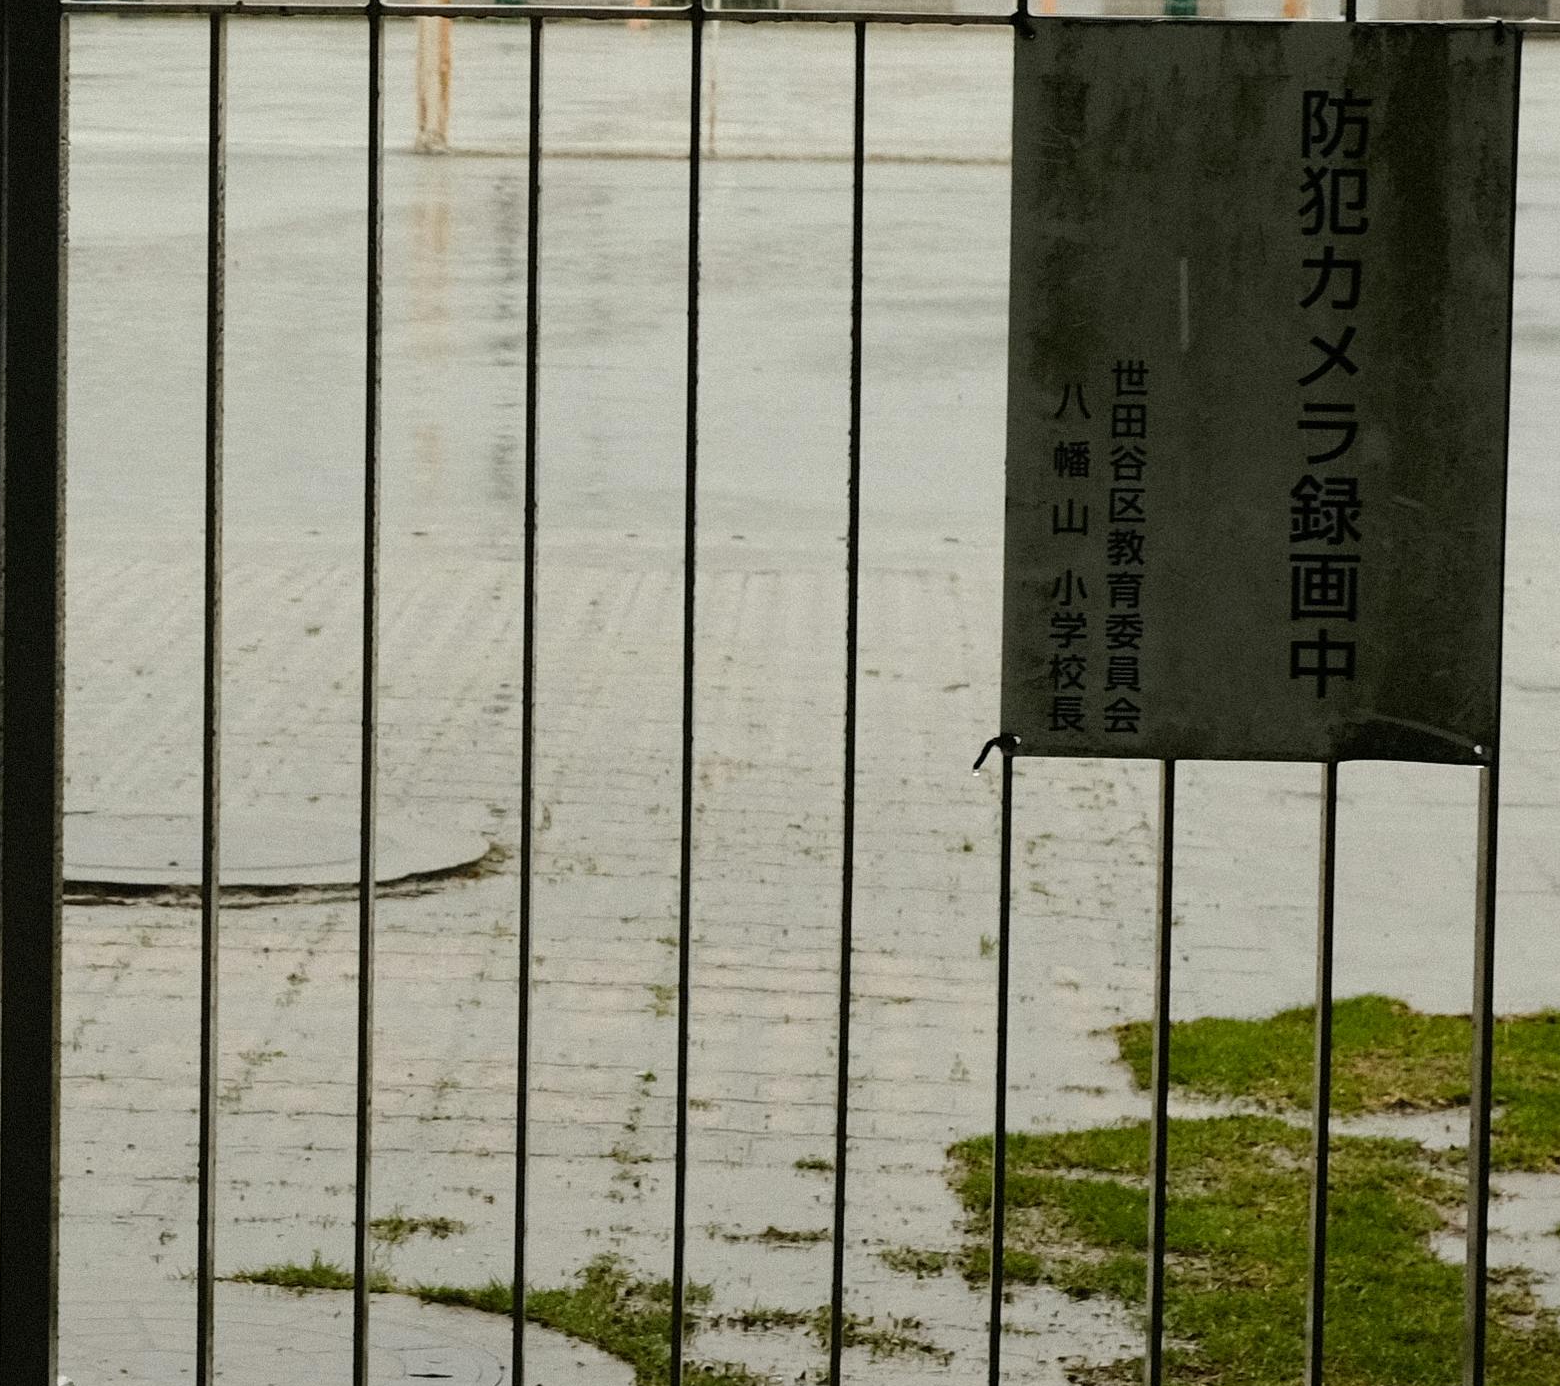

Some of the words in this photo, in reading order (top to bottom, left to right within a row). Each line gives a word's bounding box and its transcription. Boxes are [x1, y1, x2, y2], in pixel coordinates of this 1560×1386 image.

[1102, 358, 1150, 735] 世田谷区教育委員会
[1287, 89, 1373, 700] 防犯カメラ録画中
